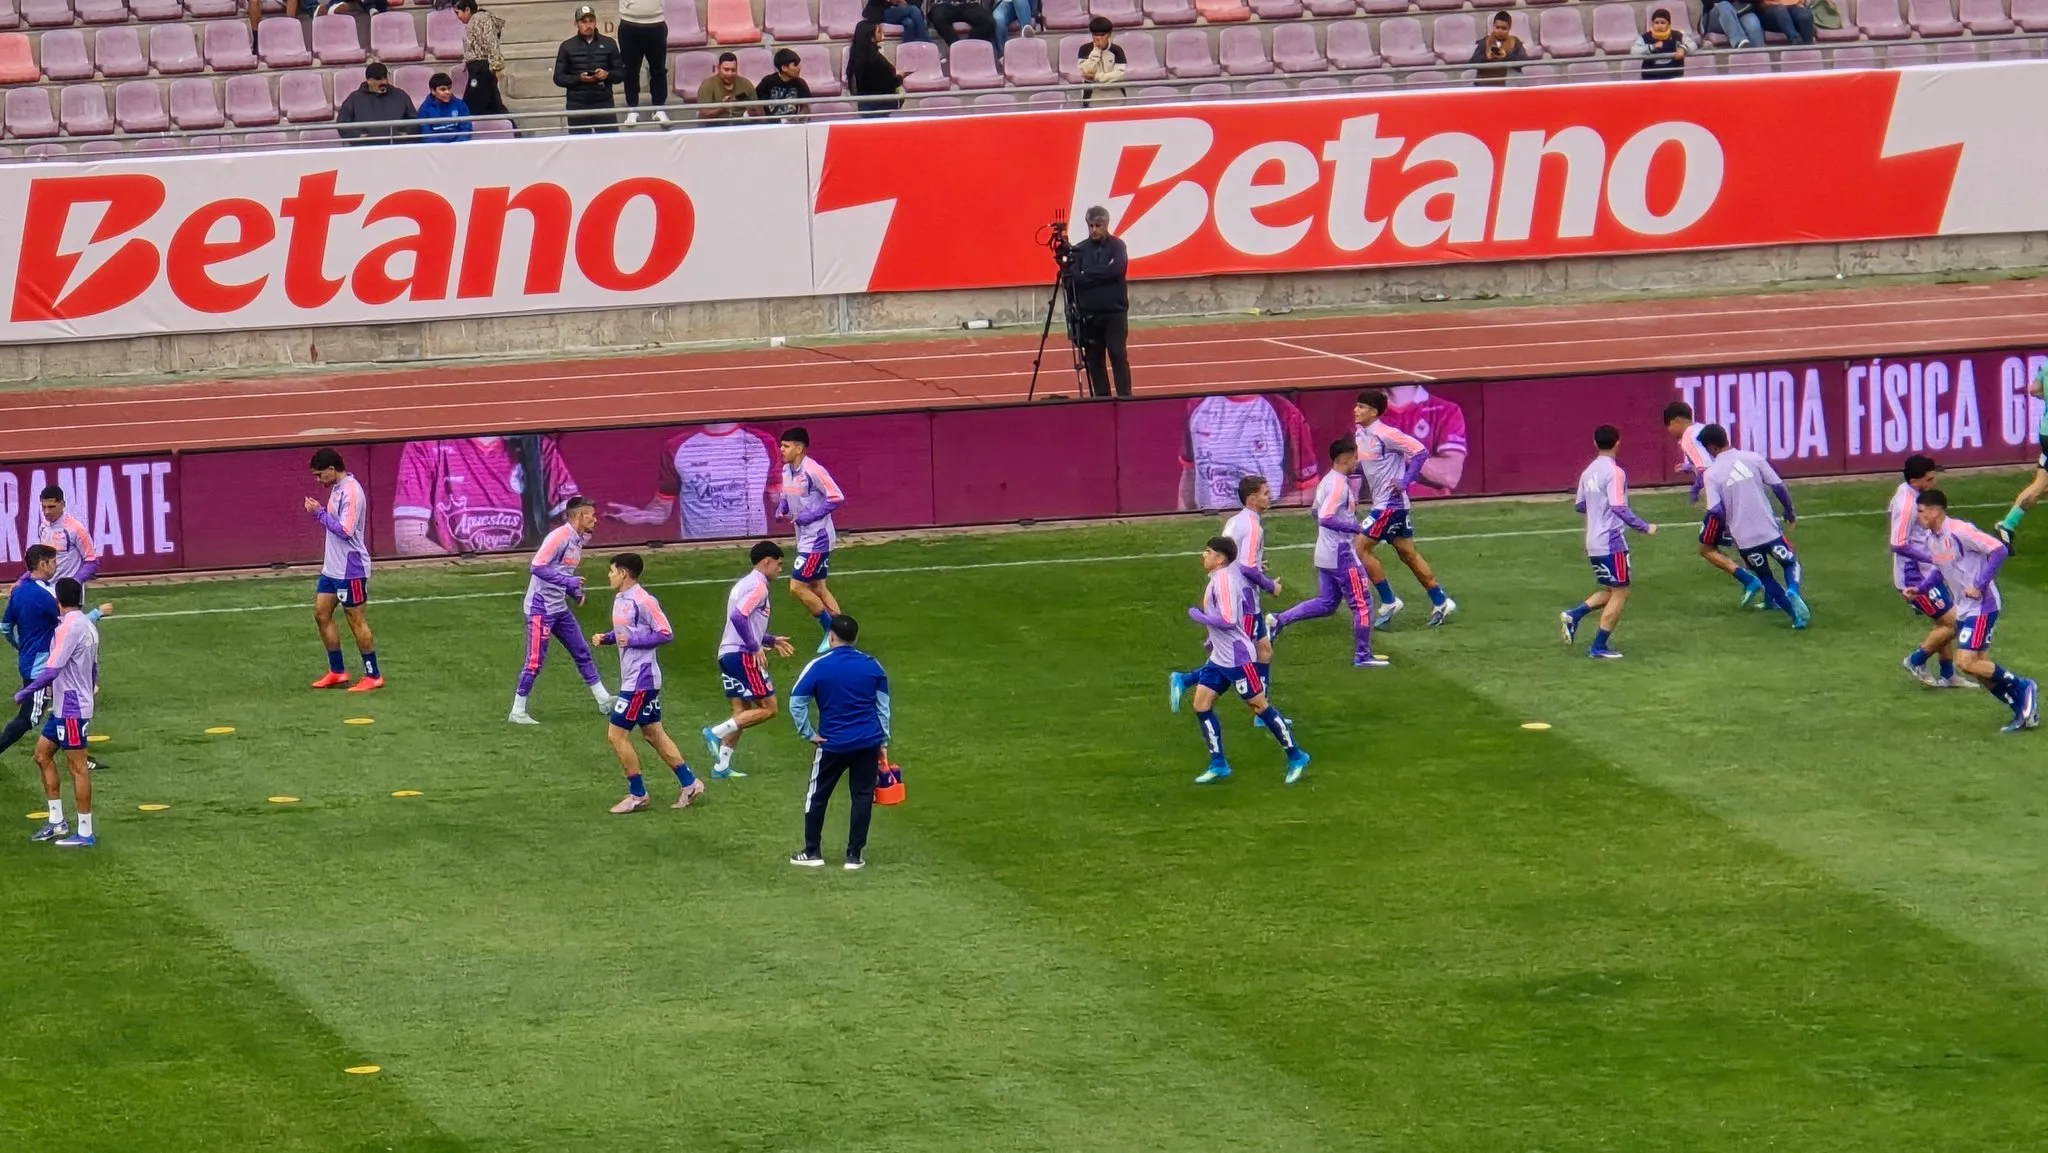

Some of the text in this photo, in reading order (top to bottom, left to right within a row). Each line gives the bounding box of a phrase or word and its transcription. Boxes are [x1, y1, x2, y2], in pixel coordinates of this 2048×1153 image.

[11, 170, 695, 323] Betano
[1068, 114, 1722, 260] Betano
[1675, 368, 1829, 460] TIENDA
[1847, 358, 1983, 455] FÍSICA
[455, 513, 521, 535] Apuestas
